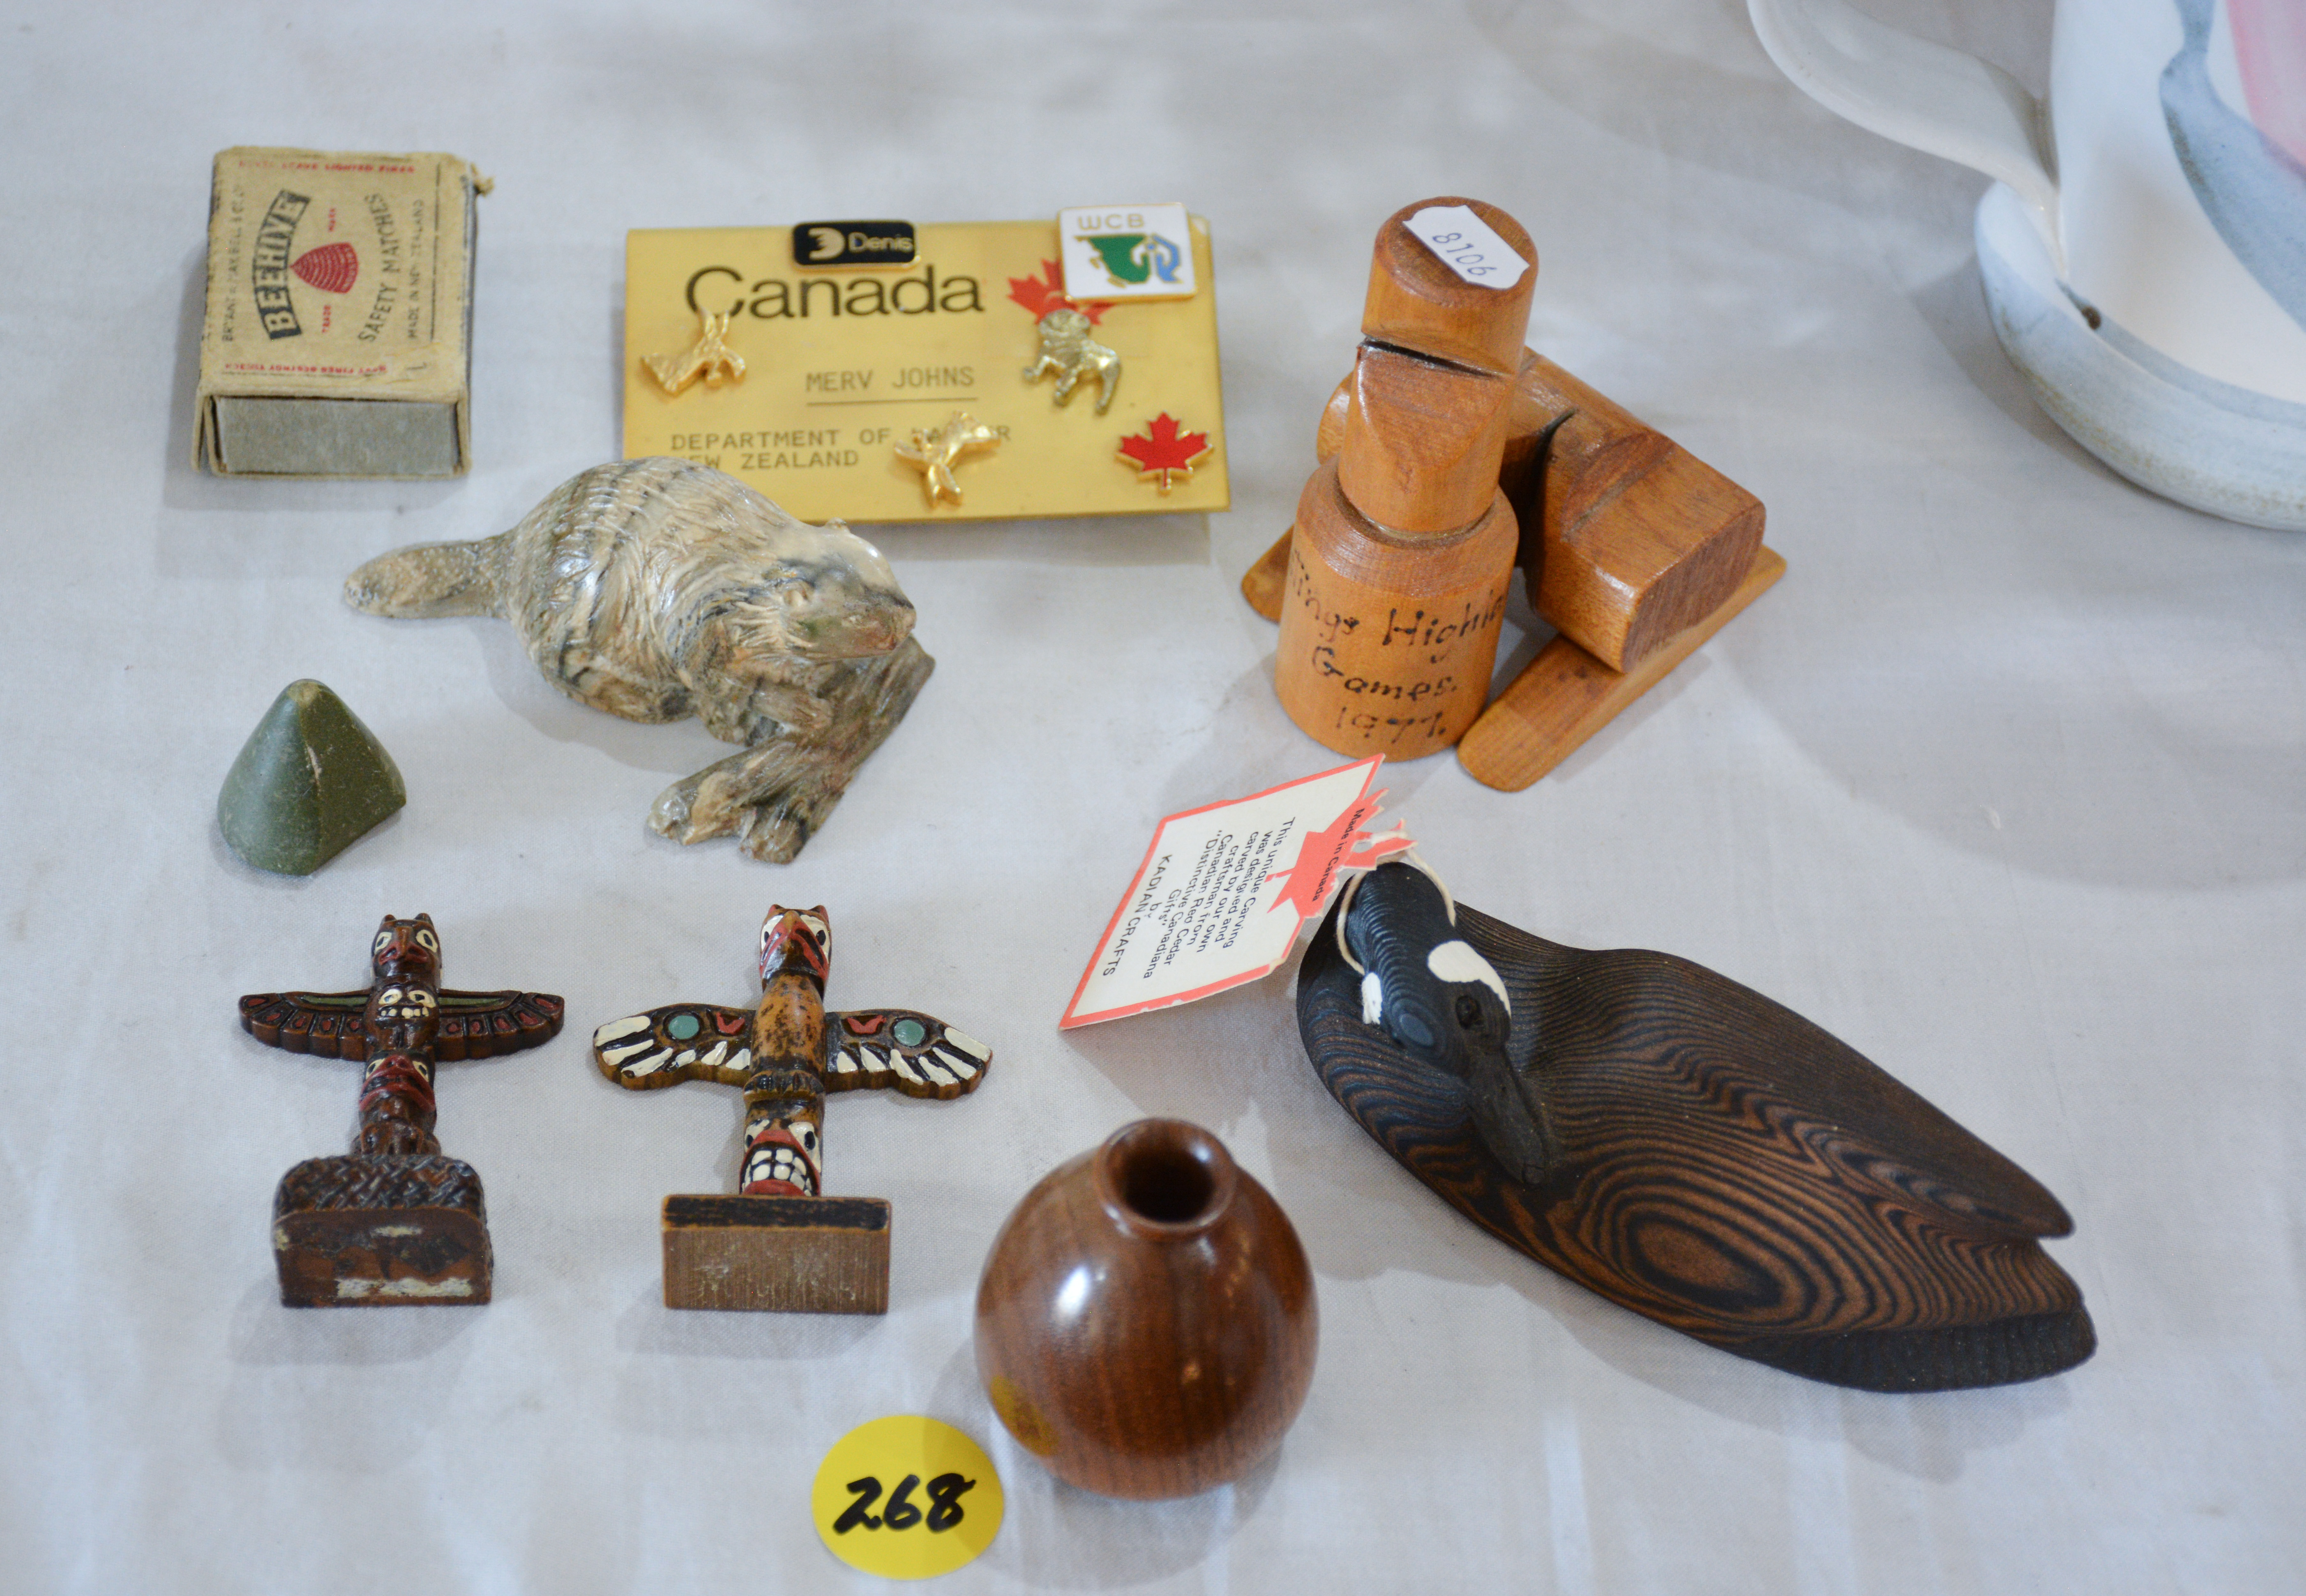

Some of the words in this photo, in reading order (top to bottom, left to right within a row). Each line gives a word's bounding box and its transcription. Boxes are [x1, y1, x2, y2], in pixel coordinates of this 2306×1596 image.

[364, 193, 401, 274] MATCHES
[1077, 213, 1146, 230] WCB
[848, 231, 914, 253] Denis
[1432, 232, 1497, 276] 8106
[253, 191, 308, 333] BEEHIVE
[409, 290, 420, 302] IN
[685, 264, 986, 319] Canada
[358, 282, 398, 342] SAFETY
[408, 307, 420, 339] MADE
[805, 371, 874, 392] MERV
[892, 366, 975, 388] JOHNS
[671, 429, 840, 450] DEPARTMENT
[858, 427, 891, 446] OF
[740, 450, 859, 471] ZEALAND
[1256, 830, 1273, 854] was
[1273, 816, 1296, 846] This
[1341, 808, 1365, 840] Made
[1198, 834, 1233, 894] Canadian
[1234, 831, 1259, 873] carved
[1334, 841, 1347, 854] in
[1135, 854, 1173, 913] KADIAN
[1178, 830, 1222, 908] "Distinctive
[1206, 845, 1239, 909] craftsman
[1223, 875, 1240, 892] by
[1250, 850, 1278, 893] unique
[1312, 856, 1339, 902] Canada
[1213, 898, 1227, 919] our
[1222, 897, 1256, 949] Carving
[1102, 917, 1141, 976] CRAFTS
[1143, 911, 1184, 979] Canadiana
[1164, 928, 1189, 966] Cedar
[1187, 912, 1211, 946] from
[1197, 924, 1215, 953] own
[1214, 918, 1231, 942] and
[832, 1472, 977, 1536] 268
